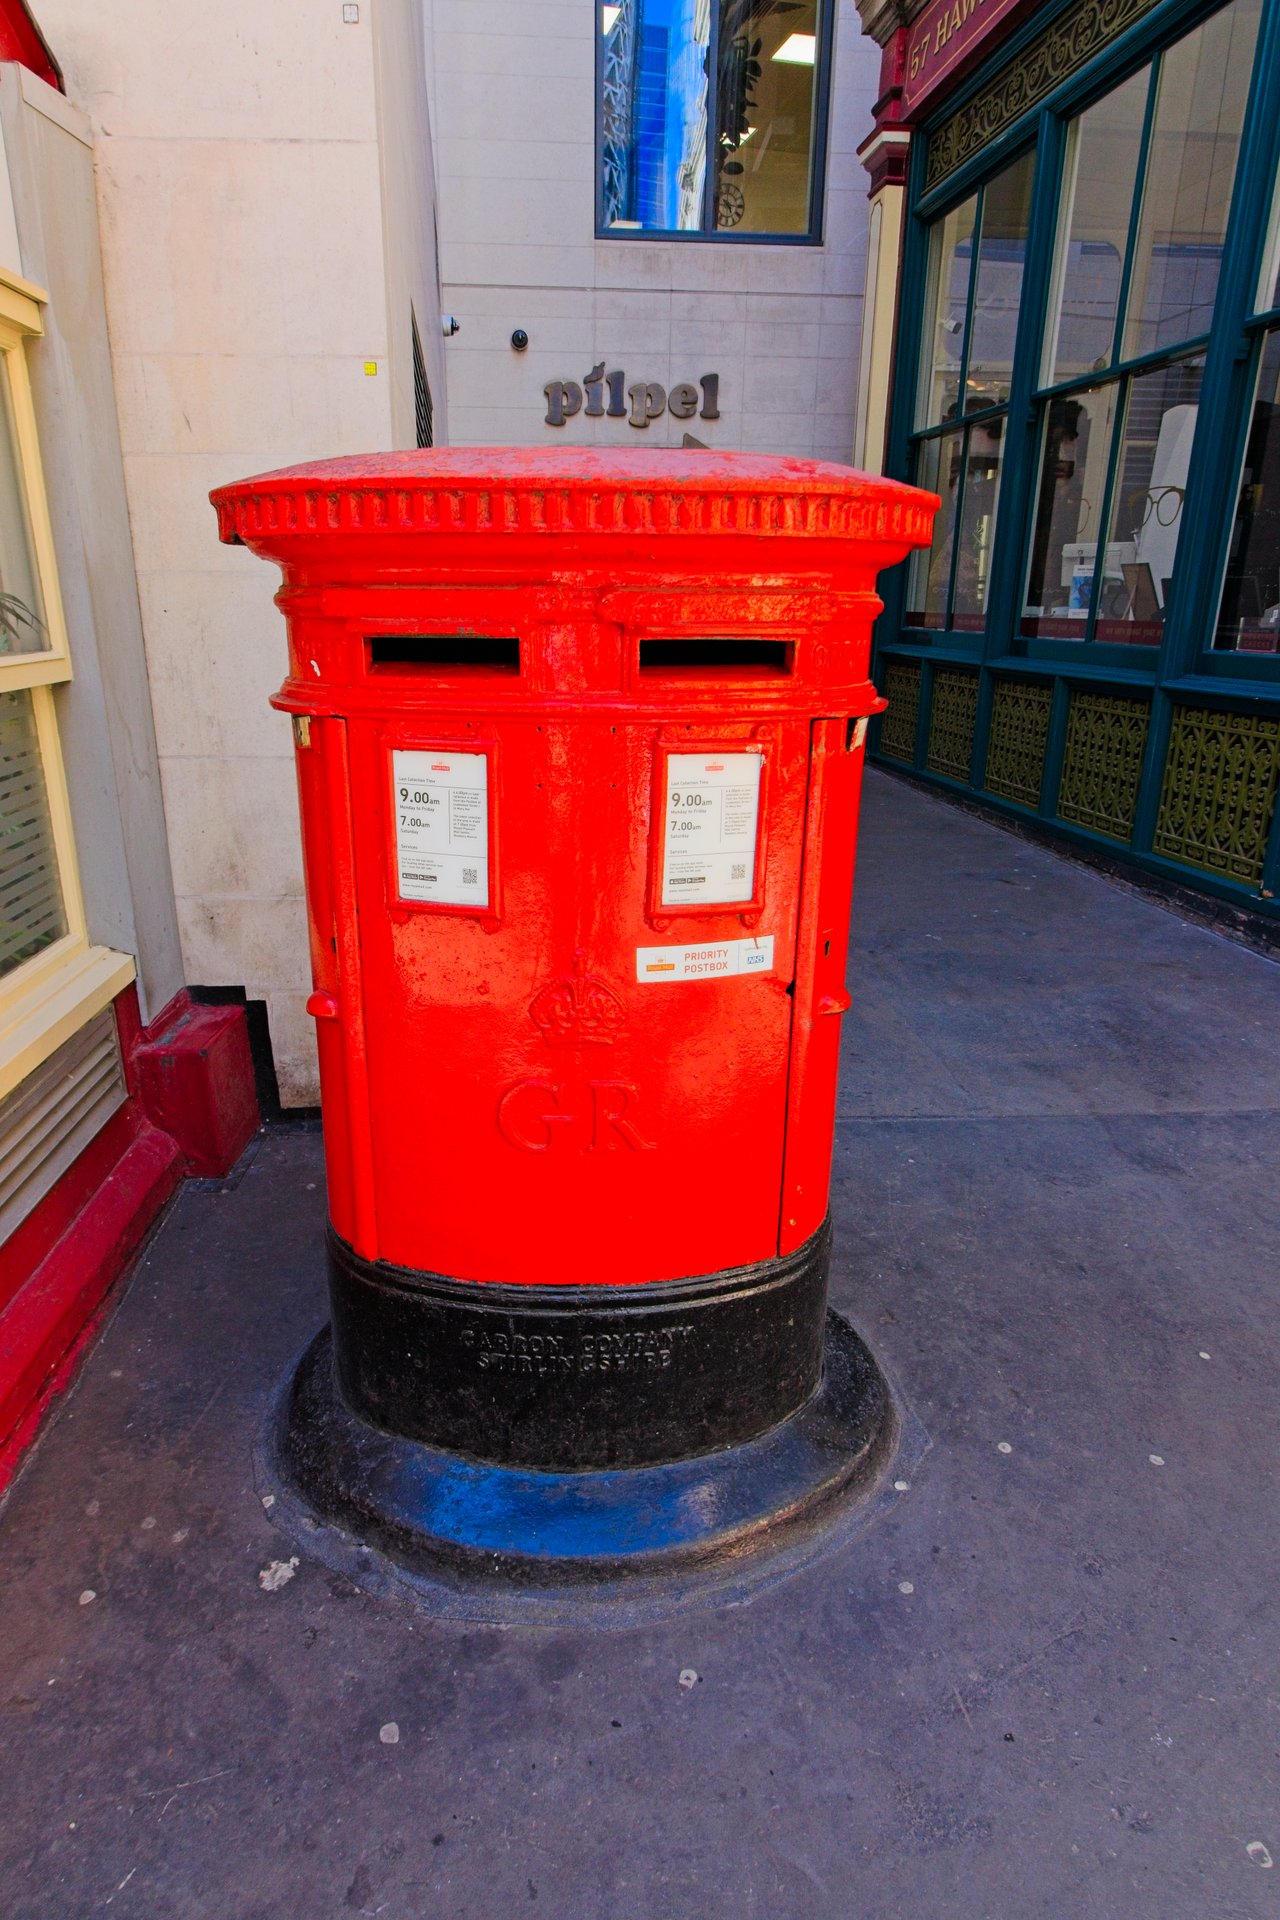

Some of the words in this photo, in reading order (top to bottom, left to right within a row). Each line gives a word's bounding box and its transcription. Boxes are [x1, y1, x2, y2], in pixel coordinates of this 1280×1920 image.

[910, 32, 931, 80] 57
[933, 0, 985, 56] HAW
[543, 361, 720, 428] pilpel
[399, 787, 440, 805] 9.00am
[671, 792, 712, 807] 9.00am
[400, 815, 431, 828] 7.00am
[670, 820, 701, 832] 7.00am
[684, 949, 729, 962] PRIORITY
[746, 954, 765, 964] NHS
[684, 961, 728, 973] POSTBOX
[460, 1328, 564, 1352] CARRON
